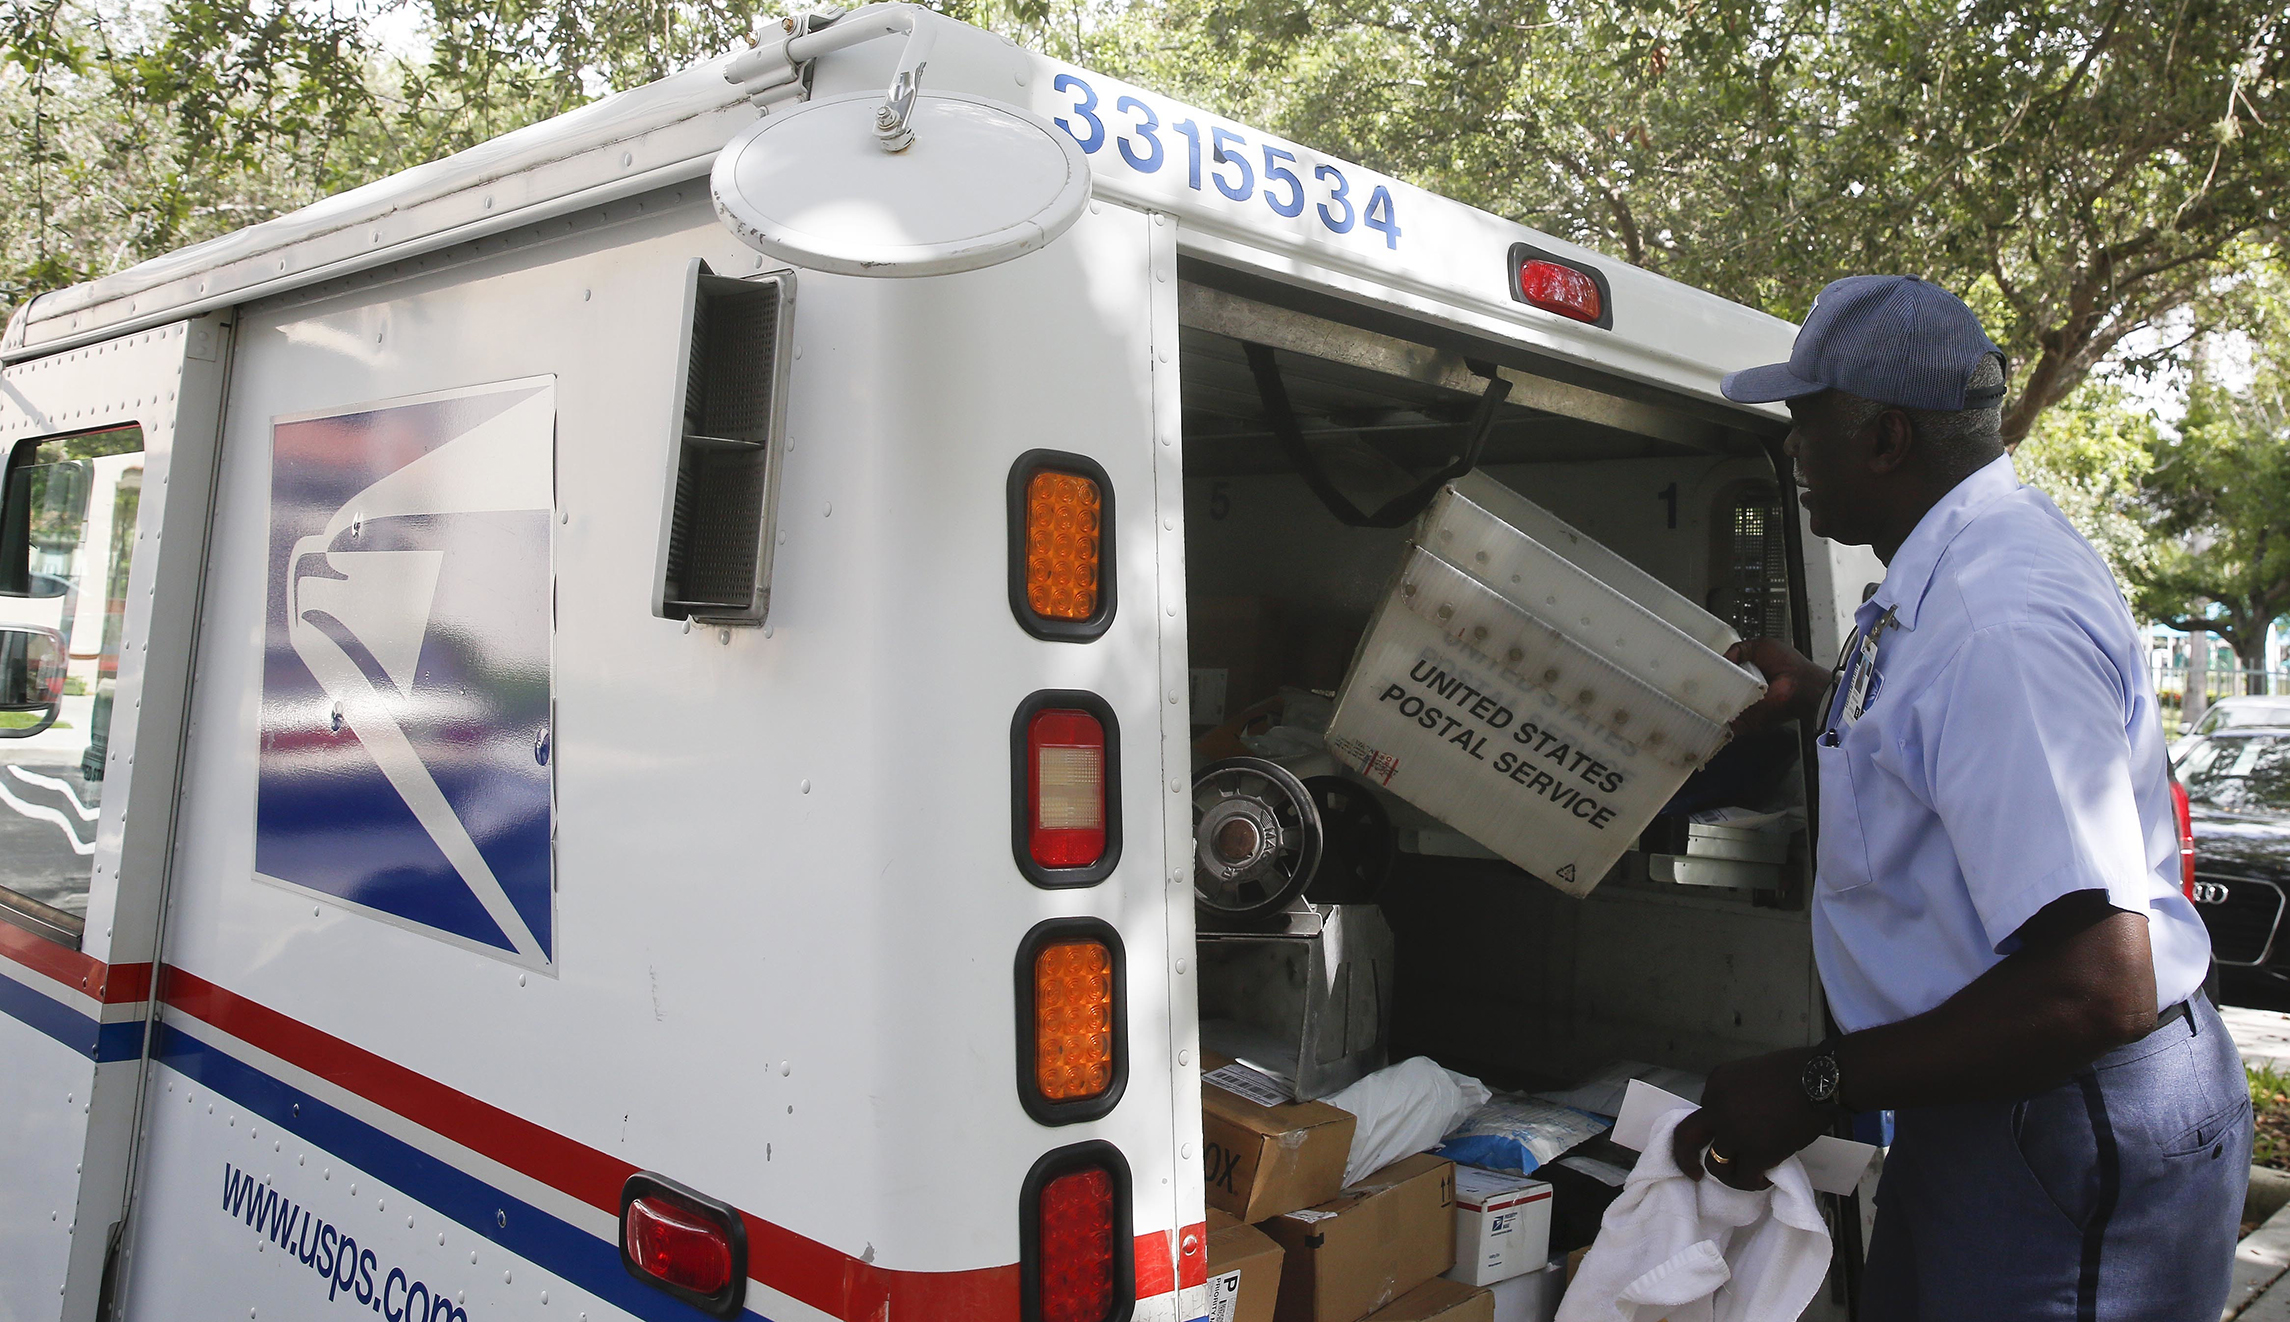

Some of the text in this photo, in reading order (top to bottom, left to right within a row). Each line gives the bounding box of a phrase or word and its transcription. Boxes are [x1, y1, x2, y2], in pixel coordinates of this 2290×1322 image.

[1053, 73, 1402, 251] 3315534
[1210, 481, 1230, 521] 5
[1658, 481, 1677, 529] 1
[1378, 683, 1488, 761] POSTAL
[1492, 751, 1617, 830] SERVICE
[1409, 659, 1624, 794] UNITED STATES
[1224, 1275, 1239, 1292] P
